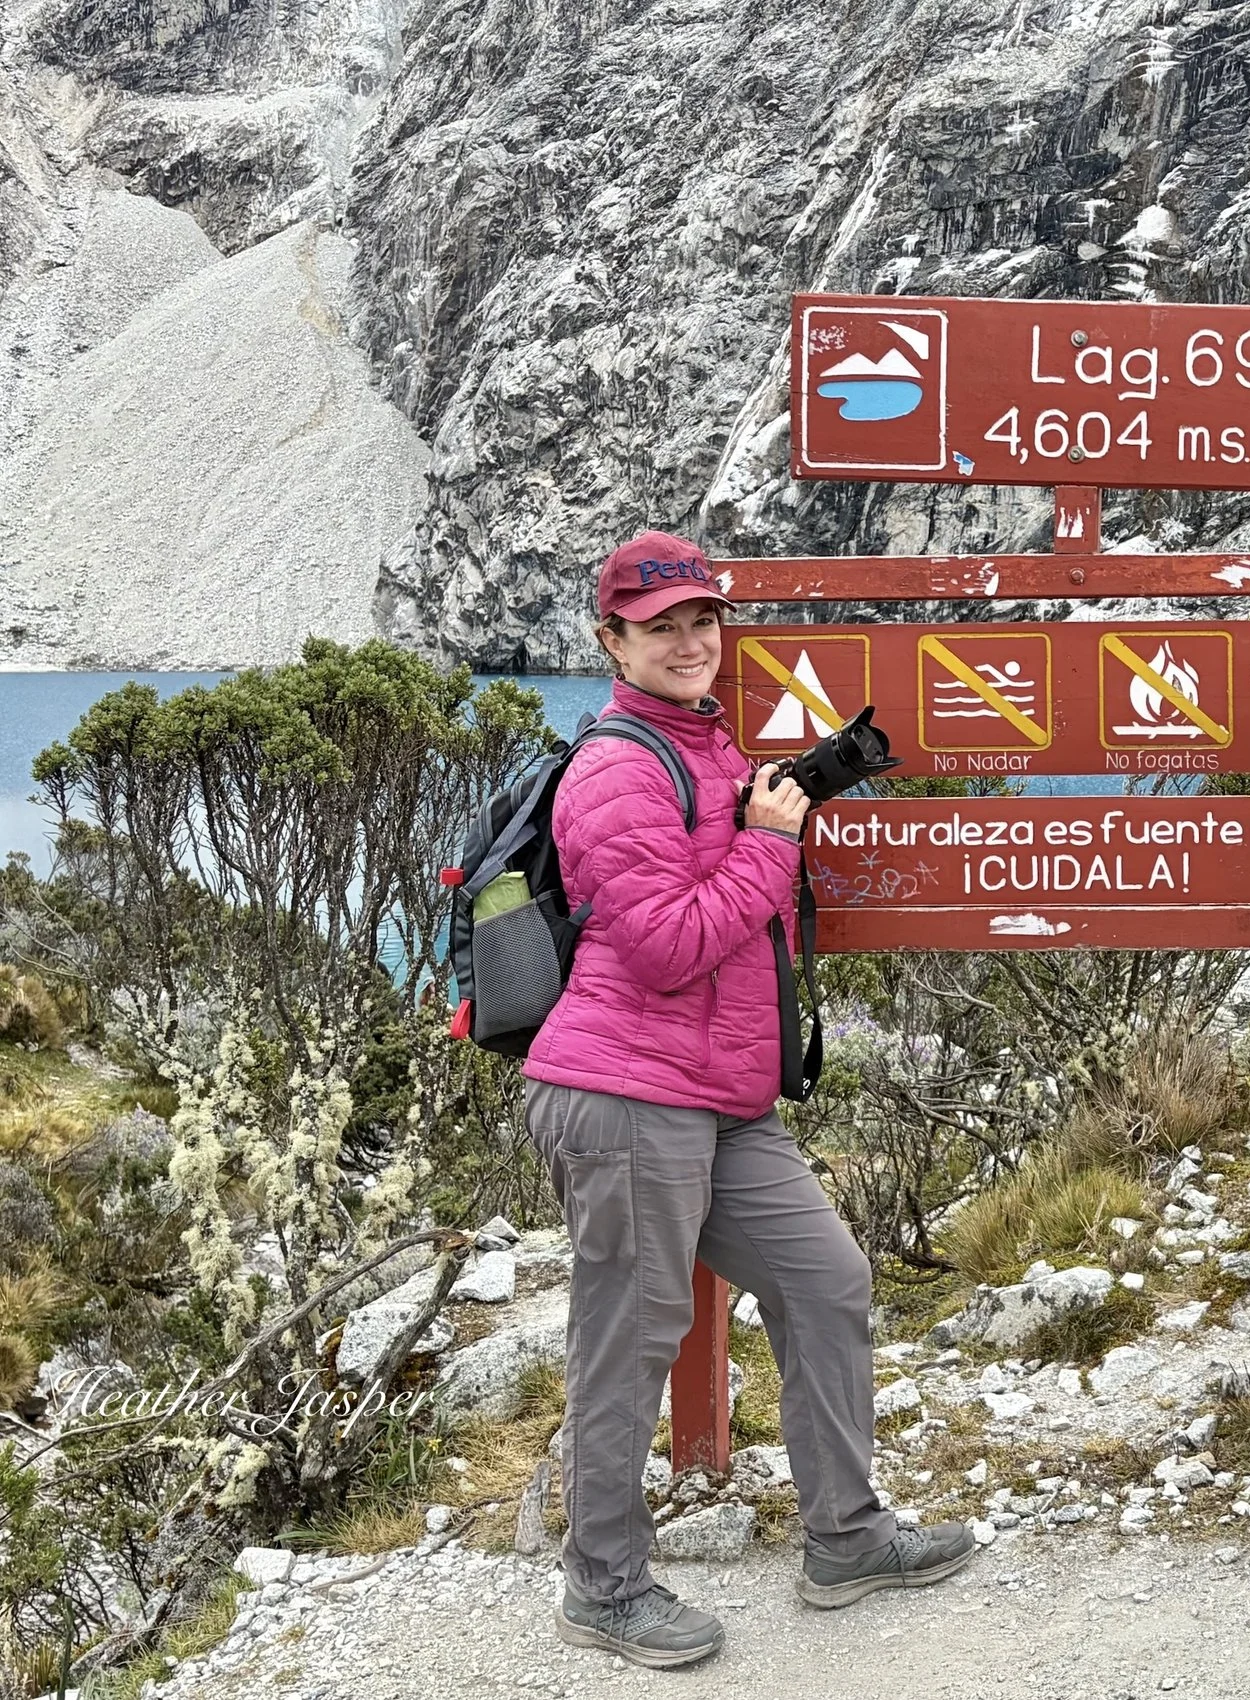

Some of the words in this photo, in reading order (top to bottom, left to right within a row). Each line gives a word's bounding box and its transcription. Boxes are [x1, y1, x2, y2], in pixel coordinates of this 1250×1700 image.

[1031, 324, 1170, 401] Lag.
[984, 406, 1154, 465] 4,604
[933, 753, 959, 771] No
[967, 751, 1033, 771] Nadar
[1105, 751, 1130, 769] No
[1136, 750, 1220, 773] fogatas
[815, 811, 1034, 847] Naturaleza
[1043, 820, 1093, 845] es
[1099, 810, 1243, 845] fuente
[964, 852, 1190, 894] ¡CUIDALA!
